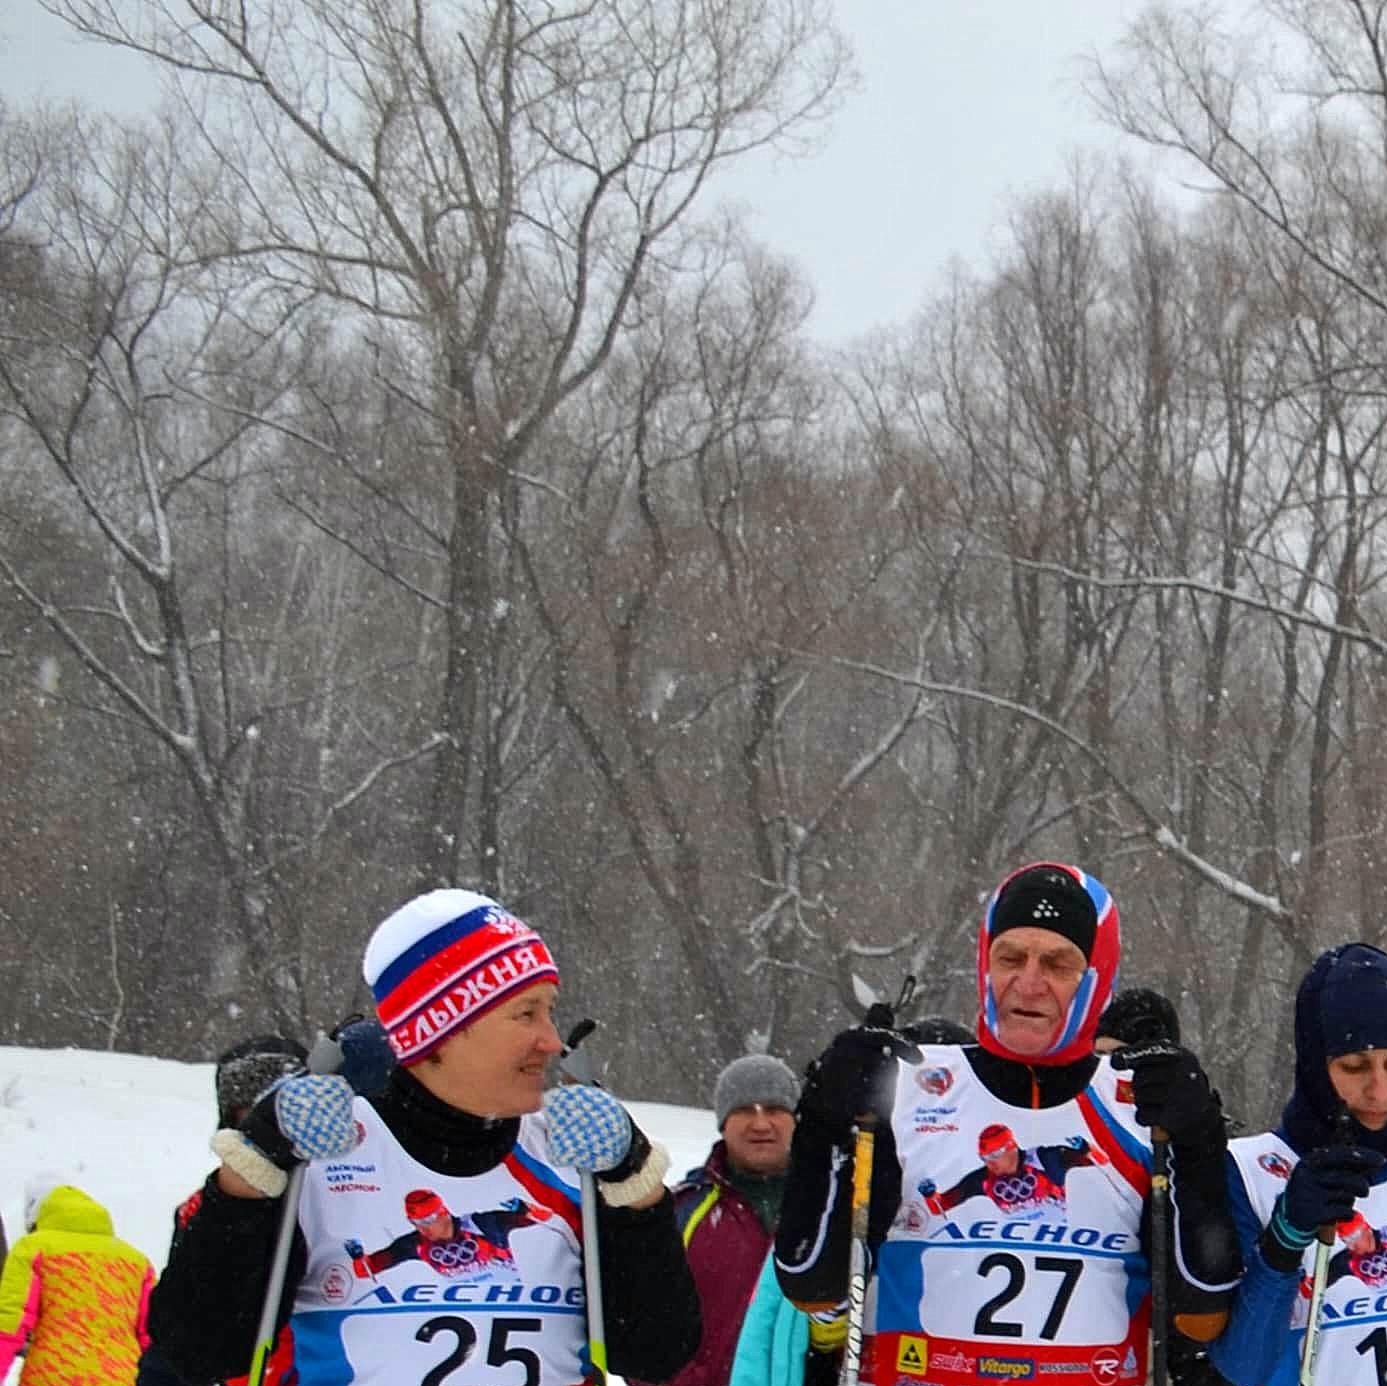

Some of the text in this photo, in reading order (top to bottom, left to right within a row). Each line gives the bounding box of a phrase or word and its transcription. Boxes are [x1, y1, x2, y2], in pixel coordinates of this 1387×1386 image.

[929, 1221, 1129, 1251] ЛЕСНОЕ
[974, 1252, 1084, 1340] 27
[980, 1358, 1032, 1377] Vitargo
